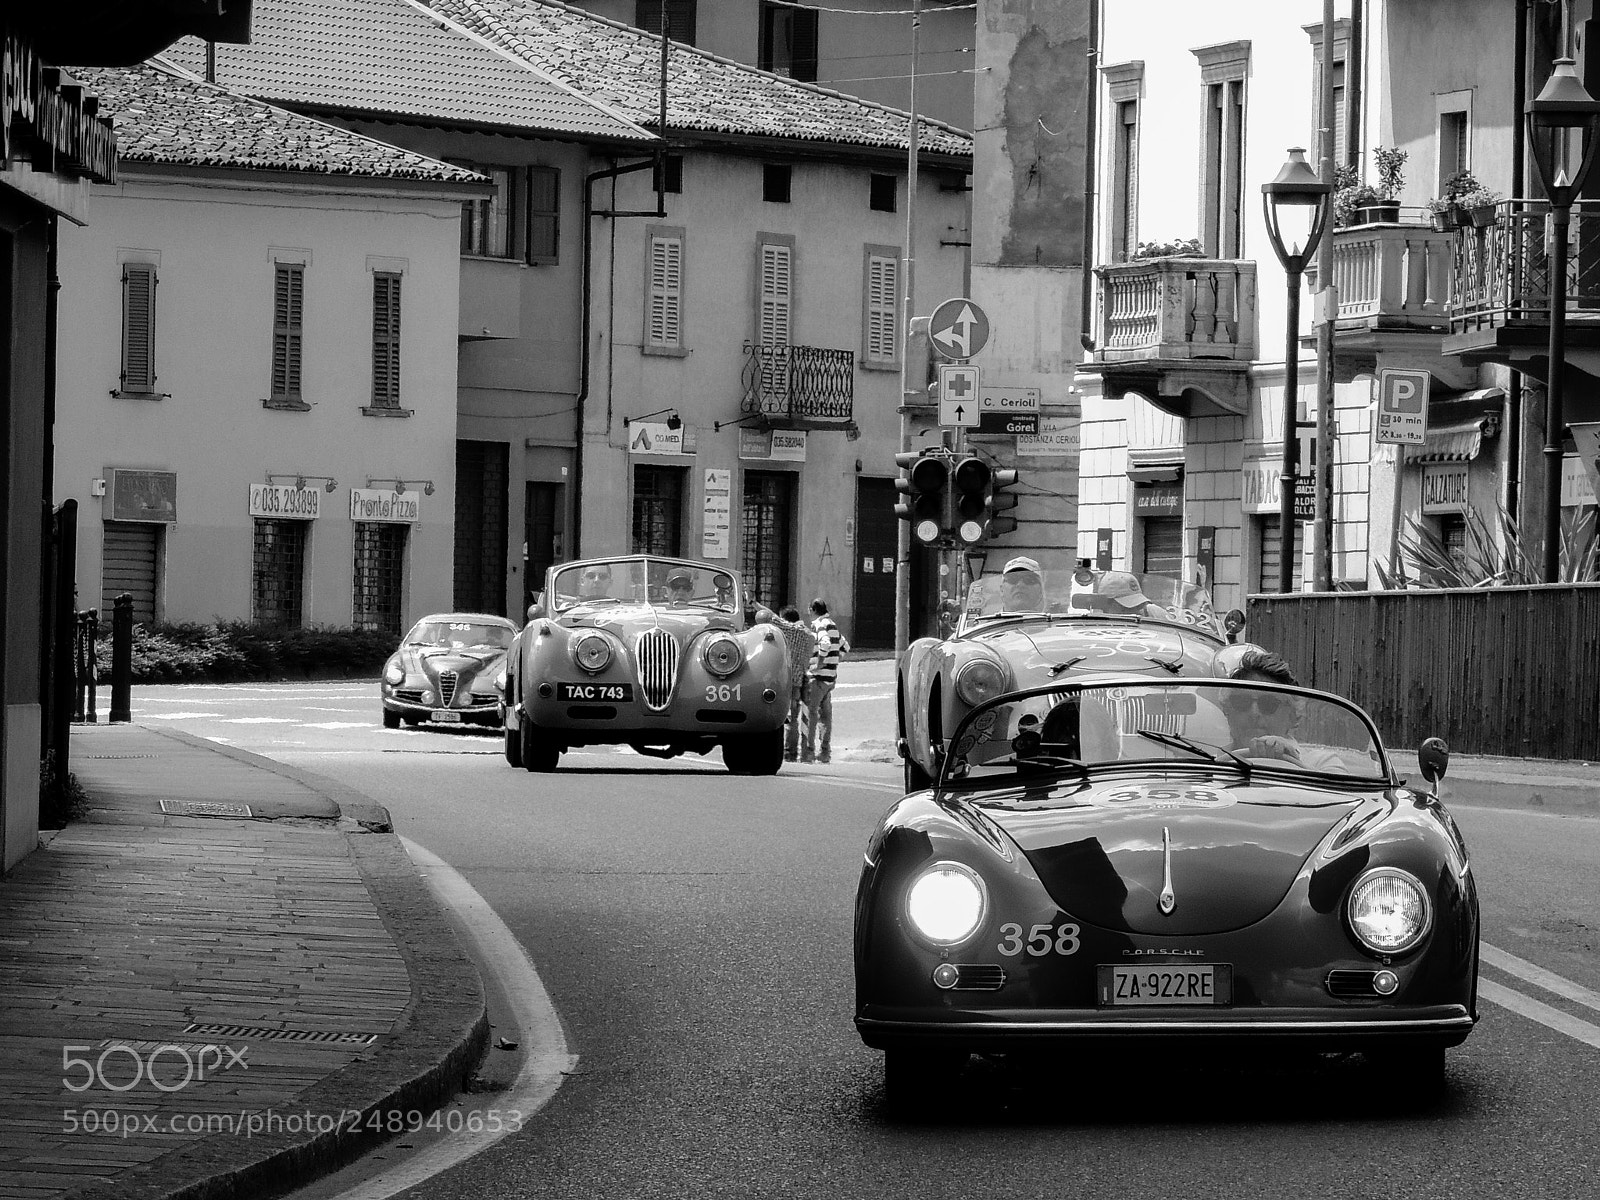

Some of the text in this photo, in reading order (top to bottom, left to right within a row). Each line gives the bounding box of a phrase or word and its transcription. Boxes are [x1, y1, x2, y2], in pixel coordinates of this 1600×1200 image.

[984, 398, 1036, 407] C. Cerioli
[1392, 415, 1422, 425] 30 min
[1243, 469, 1280, 504] TABAC
[1425, 472, 1467, 505] CALZATURE
[261, 487, 318, 515] 035.293899
[565, 685, 624, 699] TAC 743
[705, 683, 742, 703] 361
[1108, 789, 1219, 802] 358
[997, 923, 1081, 957] 358
[1122, 948, 1205, 956] PORSCHE
